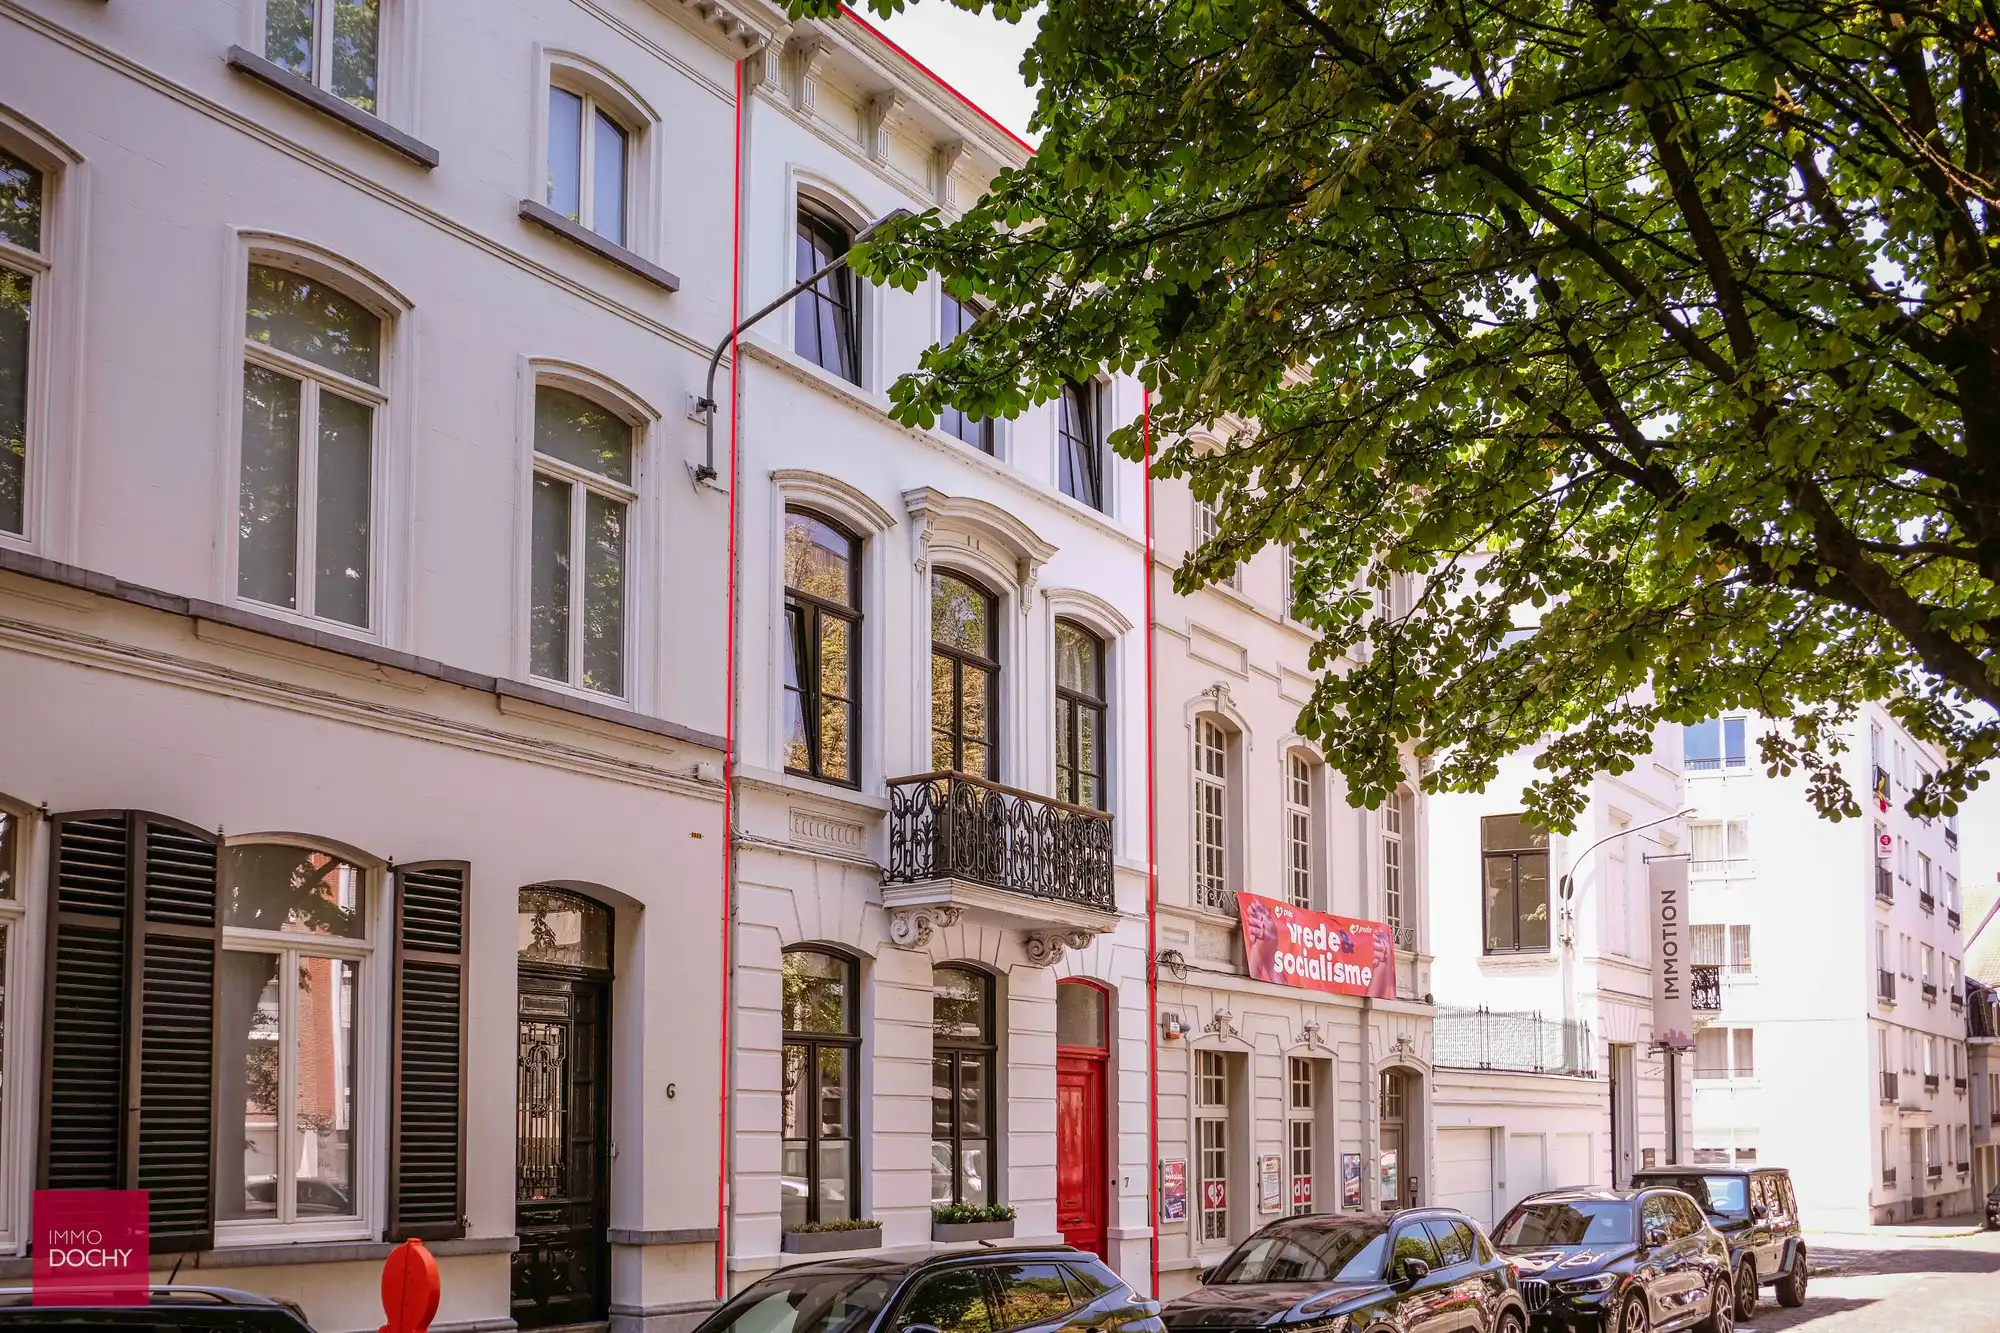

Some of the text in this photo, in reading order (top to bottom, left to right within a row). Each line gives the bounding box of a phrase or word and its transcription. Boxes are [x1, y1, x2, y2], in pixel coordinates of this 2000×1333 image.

[1661, 889, 1679, 1000] IMMOTION
[1273, 948, 1372, 987] socialisme
[666, 1082, 676, 1099] 6
[1124, 1176, 1130, 1188] 7
